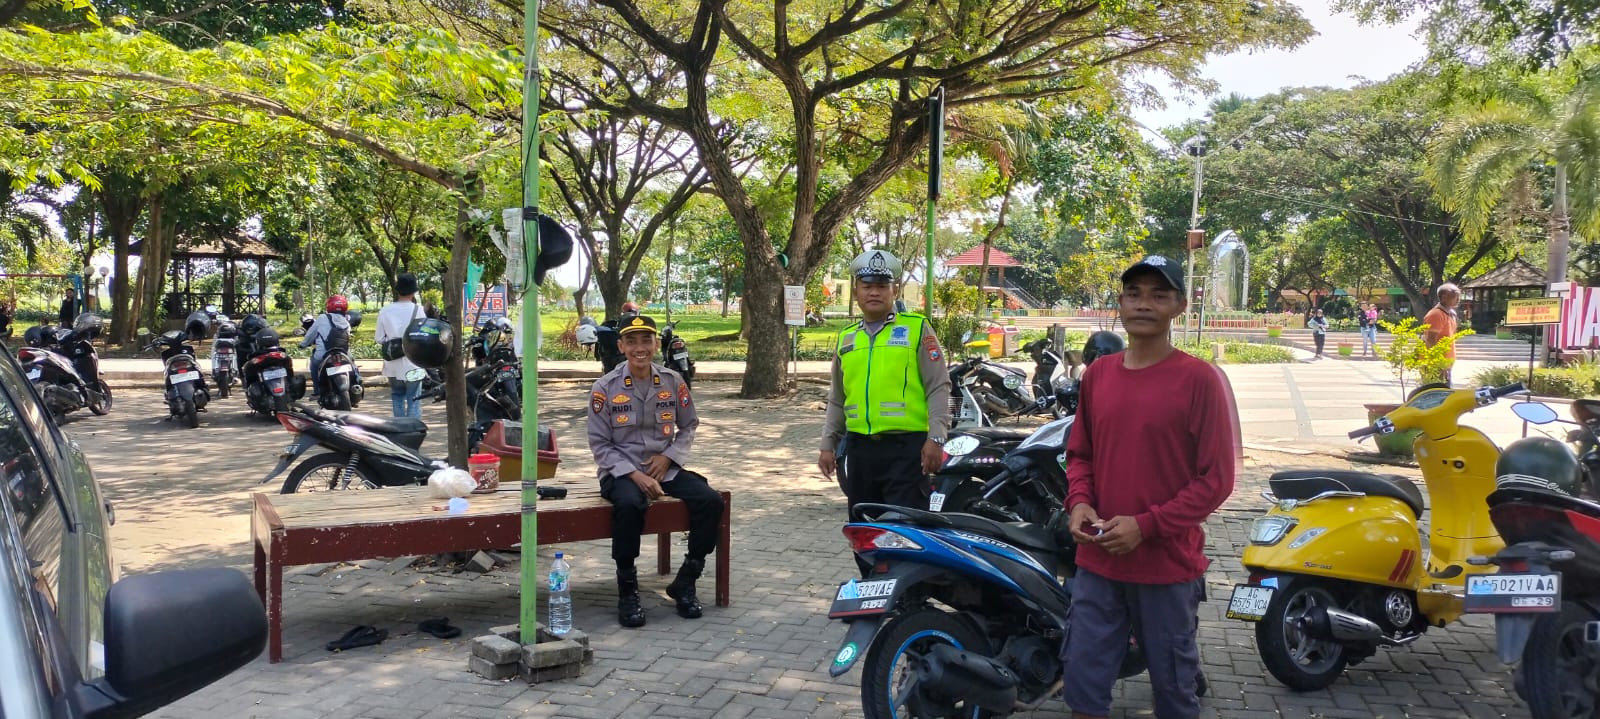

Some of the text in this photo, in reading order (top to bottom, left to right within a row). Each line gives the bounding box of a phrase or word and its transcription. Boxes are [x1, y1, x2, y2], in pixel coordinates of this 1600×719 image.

[467, 298, 504, 310] KTR
[656, 401, 676, 409] POLRI
[1247, 588, 1258, 598] AG
[1232, 597, 1251, 608] 5575
